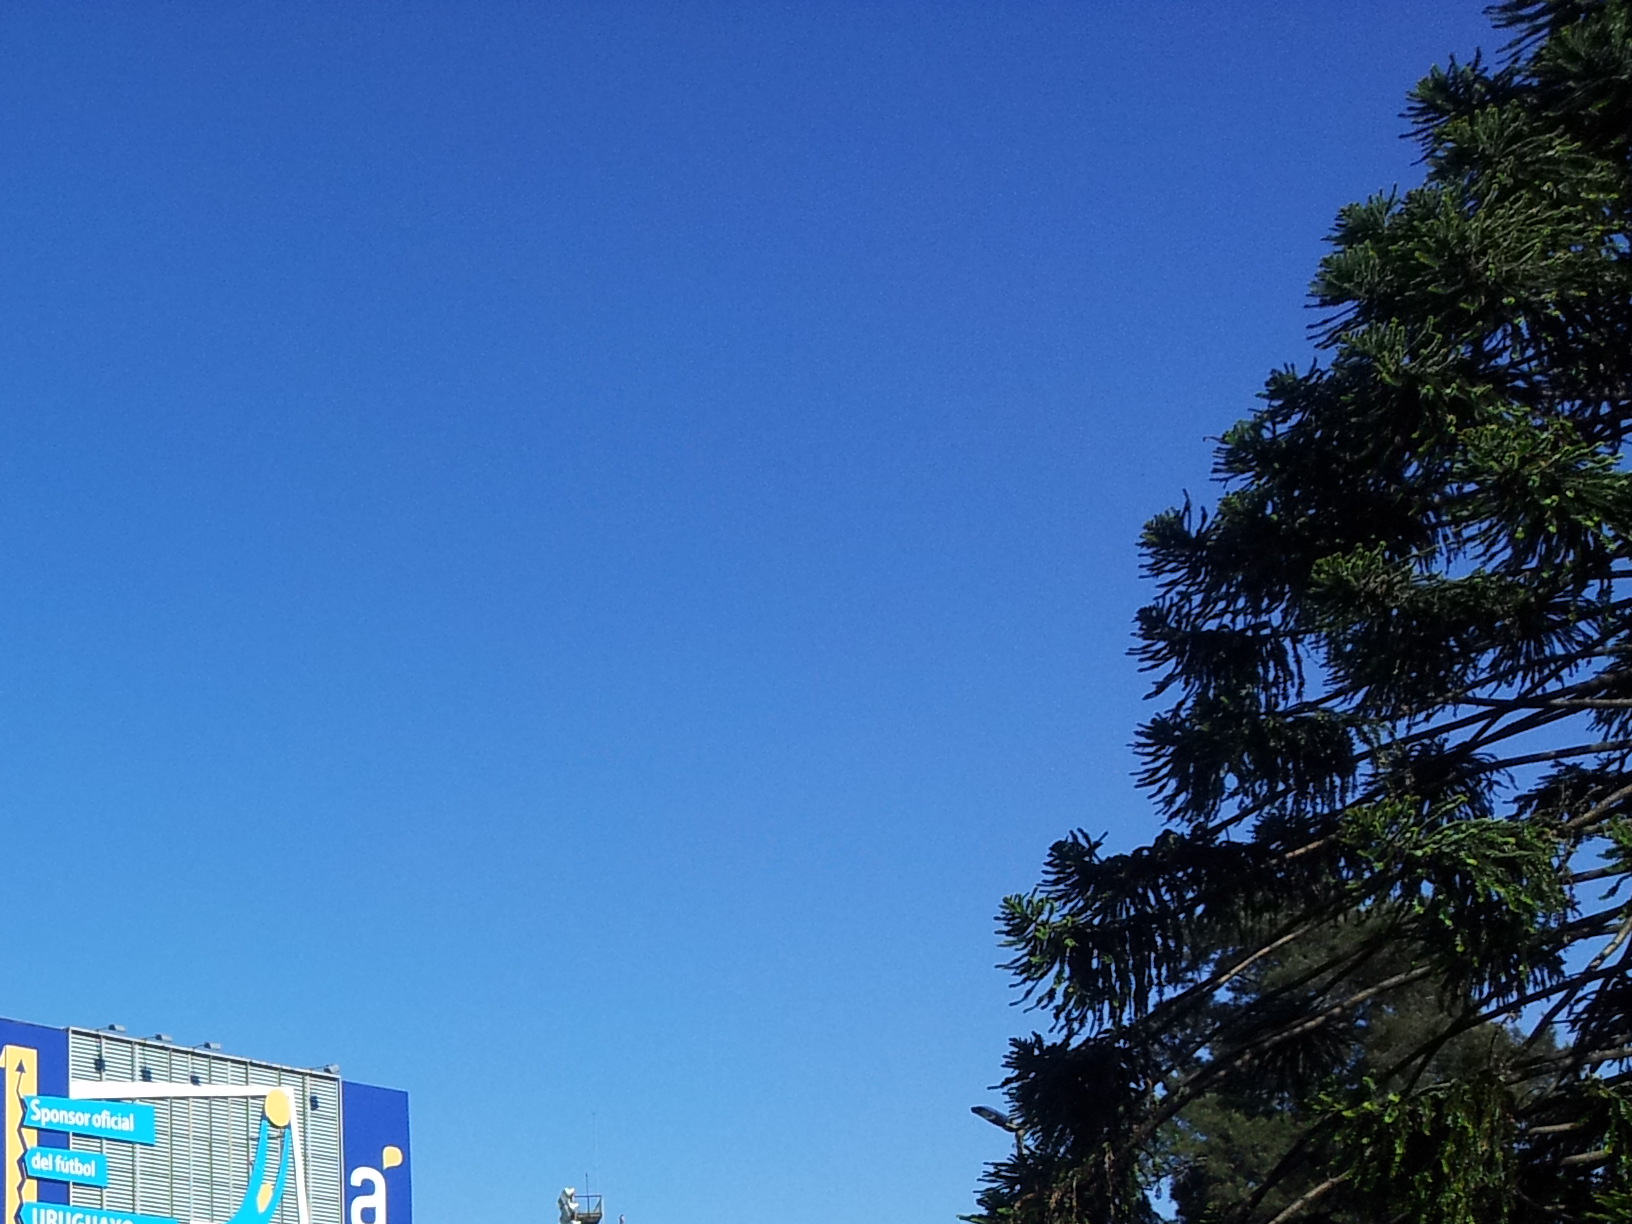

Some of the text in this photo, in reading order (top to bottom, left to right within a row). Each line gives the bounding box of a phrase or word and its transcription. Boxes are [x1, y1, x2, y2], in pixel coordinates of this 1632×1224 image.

[30, 1099, 135, 1132] Sponsor oficial
[31, 1152, 96, 1178] del fútbol
